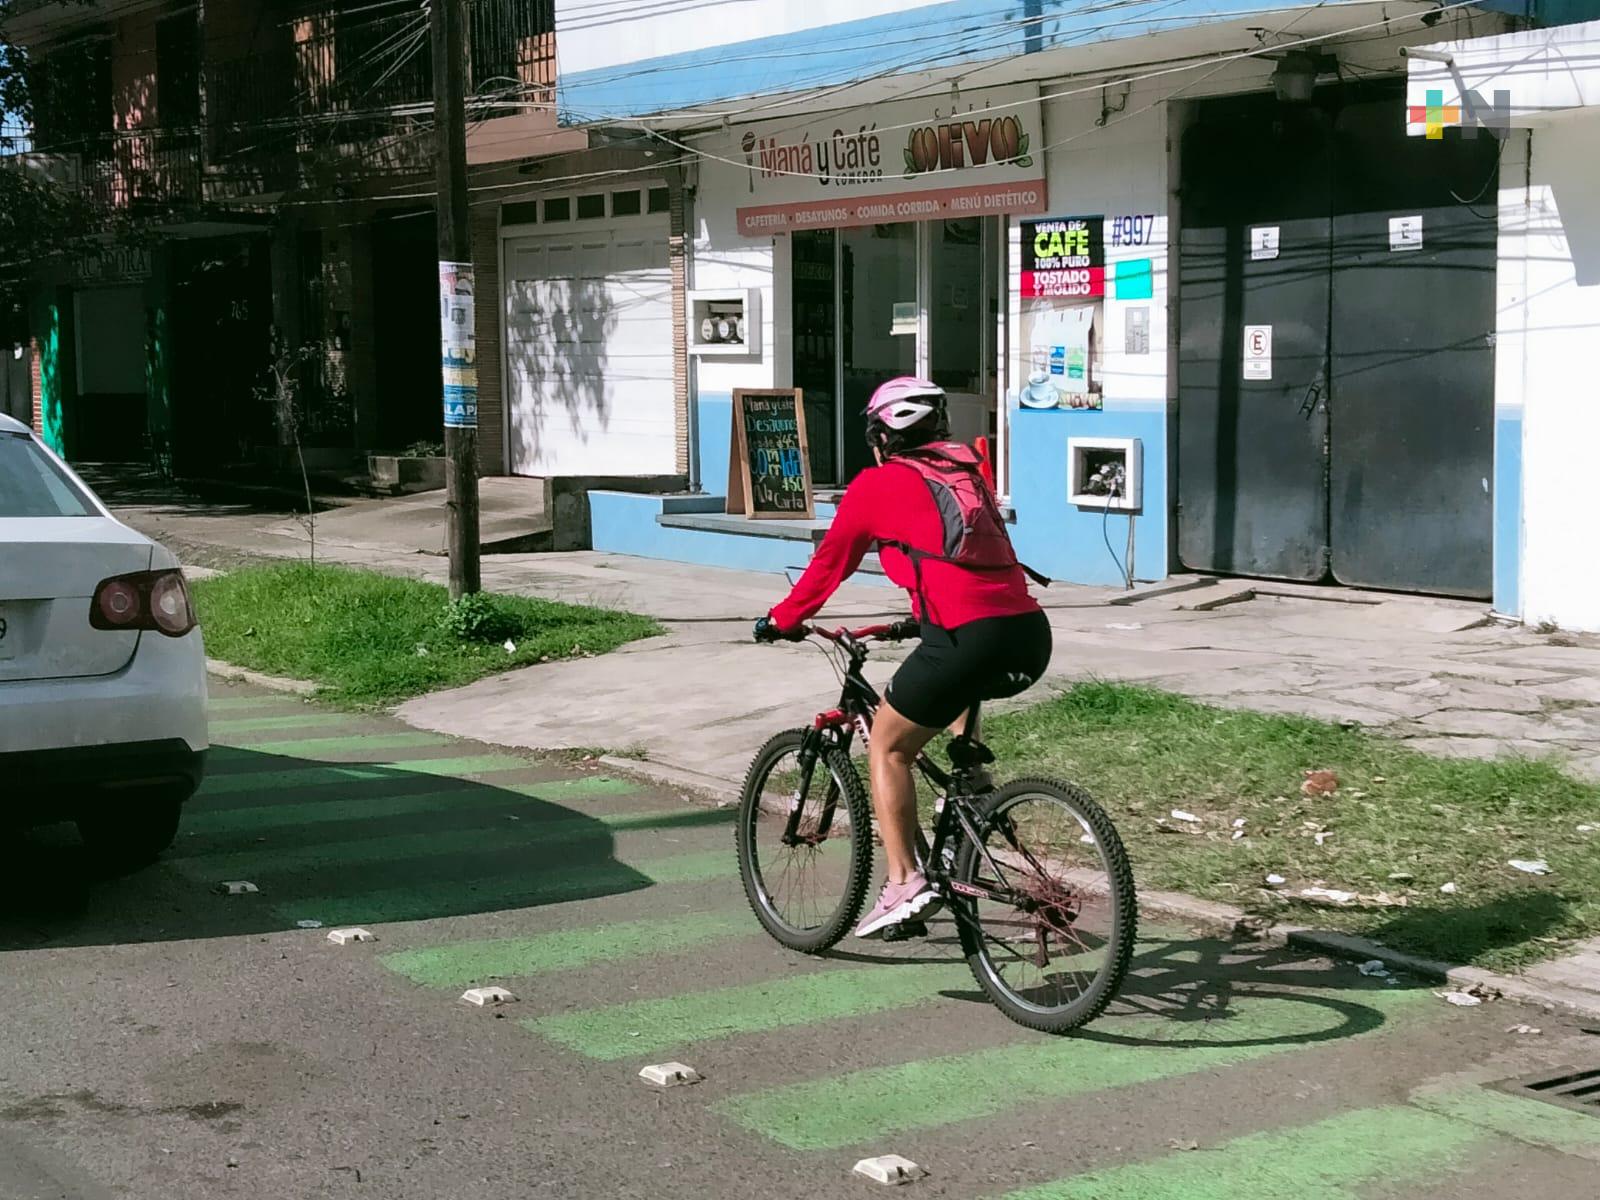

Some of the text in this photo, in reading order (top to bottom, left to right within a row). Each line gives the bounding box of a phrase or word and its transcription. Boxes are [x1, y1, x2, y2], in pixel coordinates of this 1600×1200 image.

[759, 122, 881, 185] Maná y Café
[835, 169, 883, 187] COMEDOR
[795, 207, 849, 224] DESAYUNOS
[856, 203, 896, 219] COMIDA
[897, 199, 940, 215] CORRIDA
[950, 192, 982, 210] MENÚ
[984, 189, 1037, 208] DIETÉTICO
[1035, 220, 1081, 234] VENTA DE
[1112, 214, 1154, 247] #997
[1034, 255, 1090, 269] 100% PURO
[1033, 270, 1091, 284] TOSTADO
[1043, 283, 1091, 296] MOLIDO
